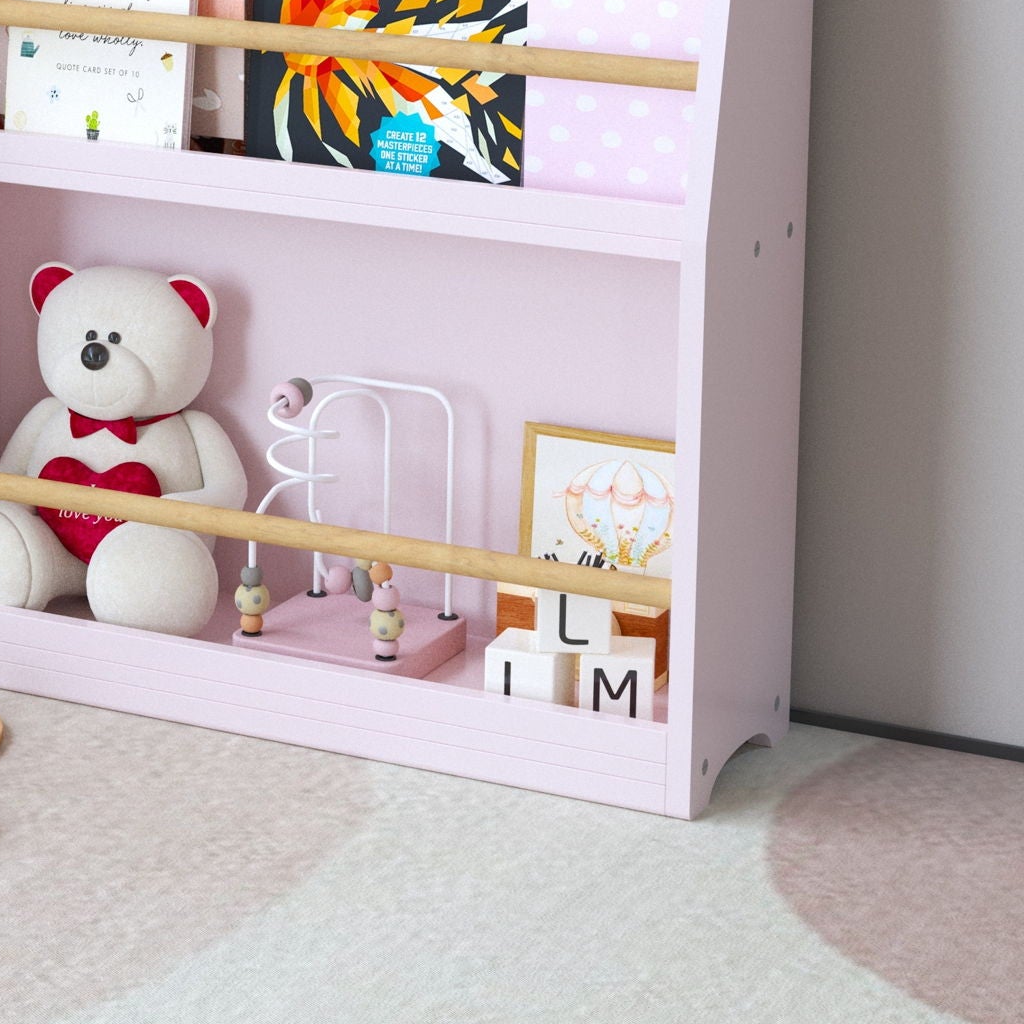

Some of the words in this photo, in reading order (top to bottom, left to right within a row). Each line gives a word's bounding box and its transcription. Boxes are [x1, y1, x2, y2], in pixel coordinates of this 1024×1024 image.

[56, 62, 80, 72] QUOTE
[82, 65, 102, 75] CARD
[104, 67, 116, 76] SET
[118, 69, 128, 77] OF
[131, 70, 140, 79] 10
[386, 130, 414, 142] CREATE
[416, 132, 427, 143] 12
[377, 139, 433, 154] MASTERPIECES
[380, 150, 396, 160] ONE
[397, 152, 429, 164] STICKER
[385, 161, 394, 170] AT
[395, 162, 401, 170] A
[402, 162, 423, 173] TIME!
[558, 593, 589, 646] L
[592, 667, 638, 719] M
